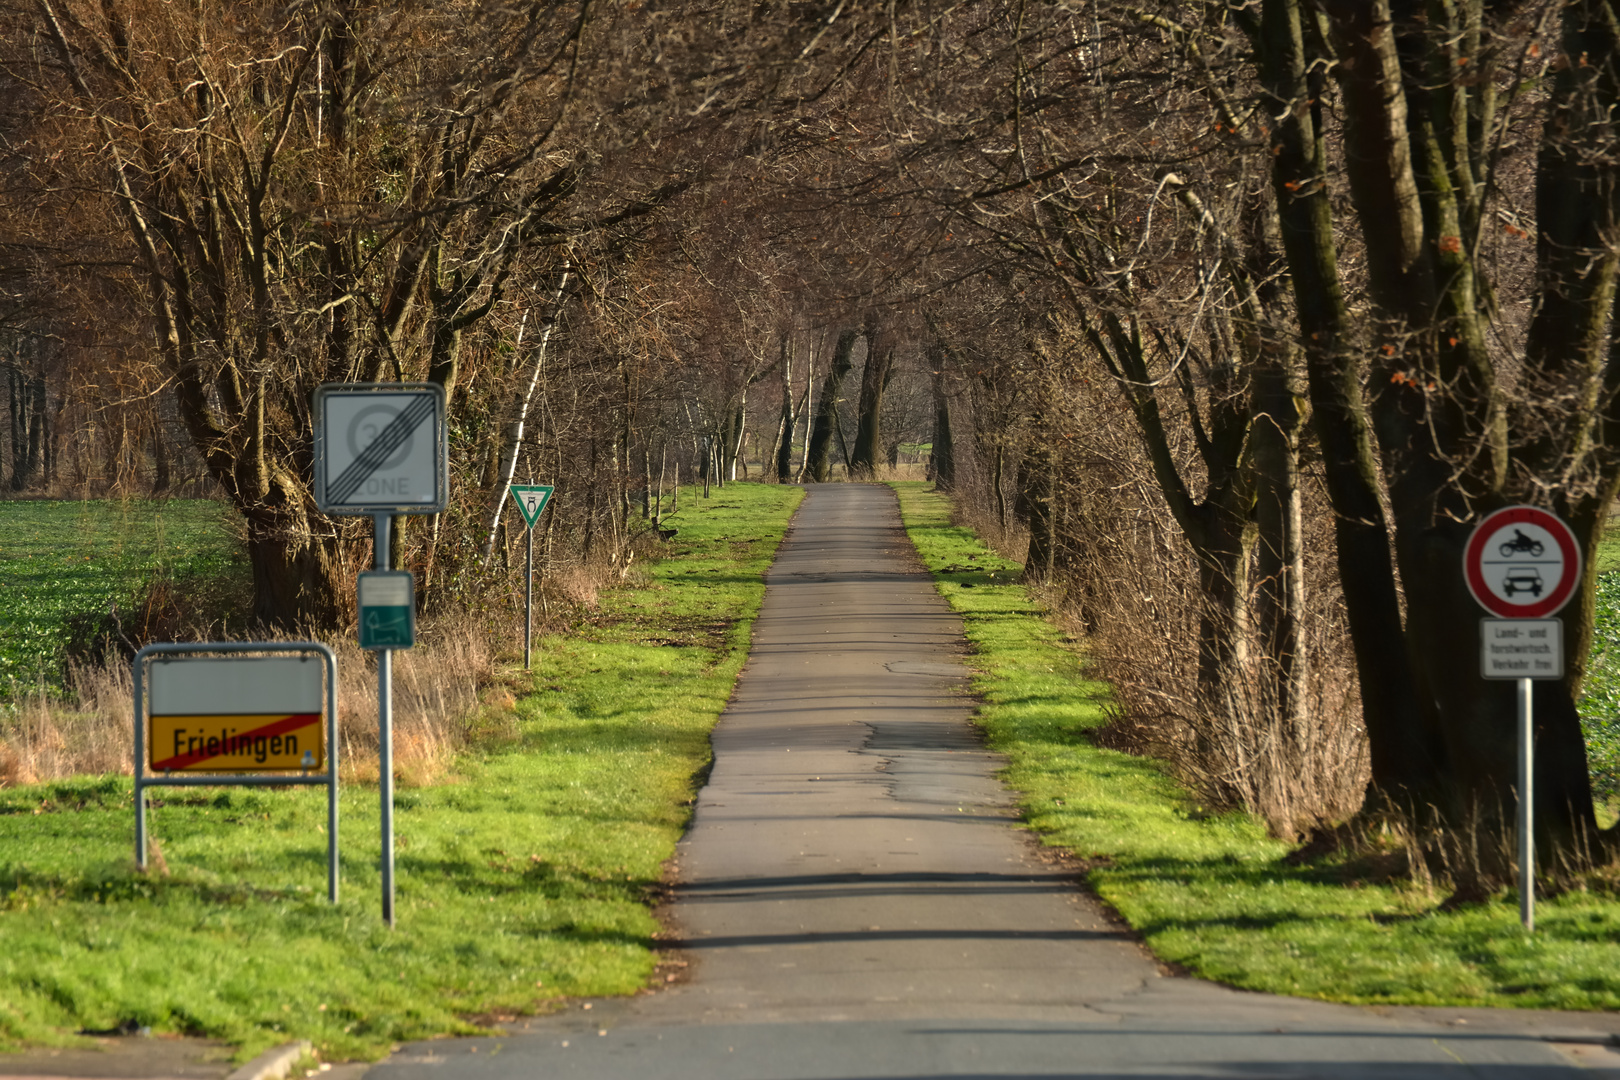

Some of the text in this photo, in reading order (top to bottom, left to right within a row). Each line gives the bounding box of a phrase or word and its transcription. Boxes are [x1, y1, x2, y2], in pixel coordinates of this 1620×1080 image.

[1494, 627, 1547, 639] Land- und
[173, 728, 298, 764] Frielingen
